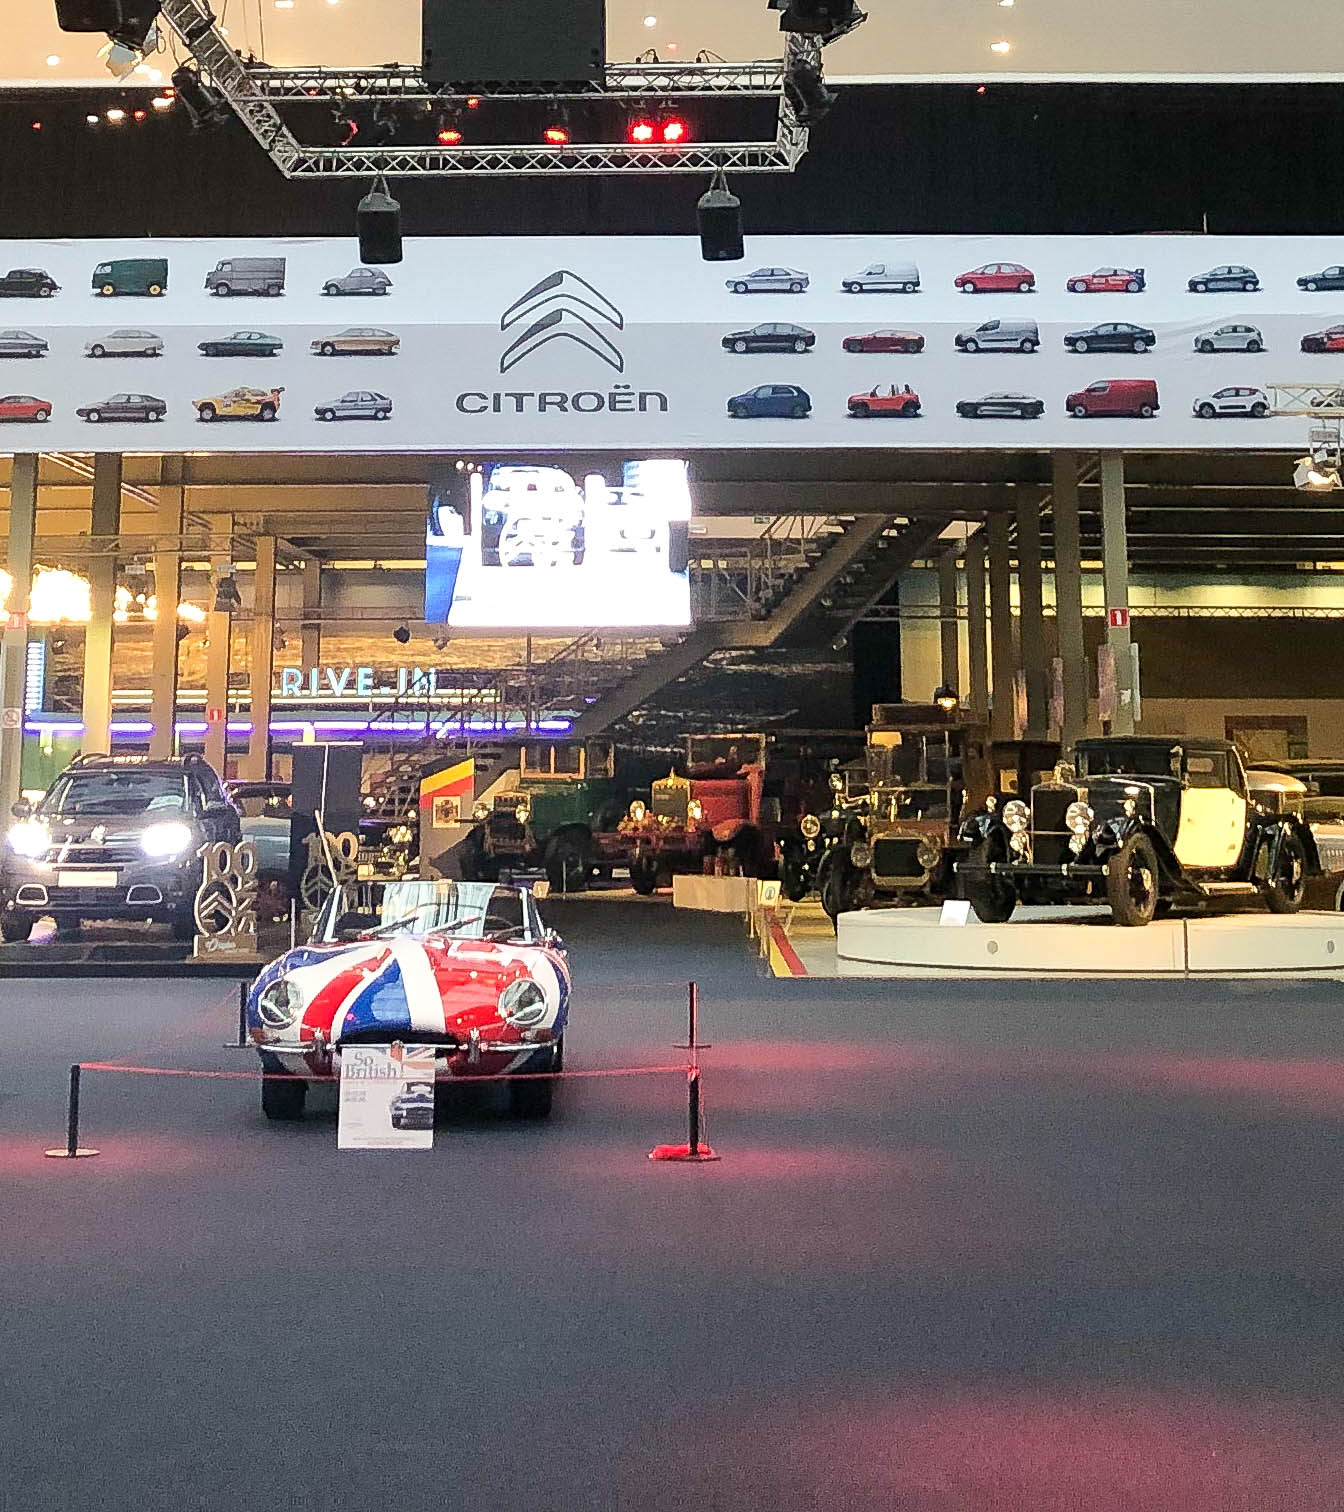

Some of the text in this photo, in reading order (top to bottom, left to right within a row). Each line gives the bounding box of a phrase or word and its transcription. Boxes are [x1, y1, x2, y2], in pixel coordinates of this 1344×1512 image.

[455, 384, 669, 413] CITROËN
[281, 667, 437, 696] RIVE-IN
[353, 1051, 374, 1066] So
